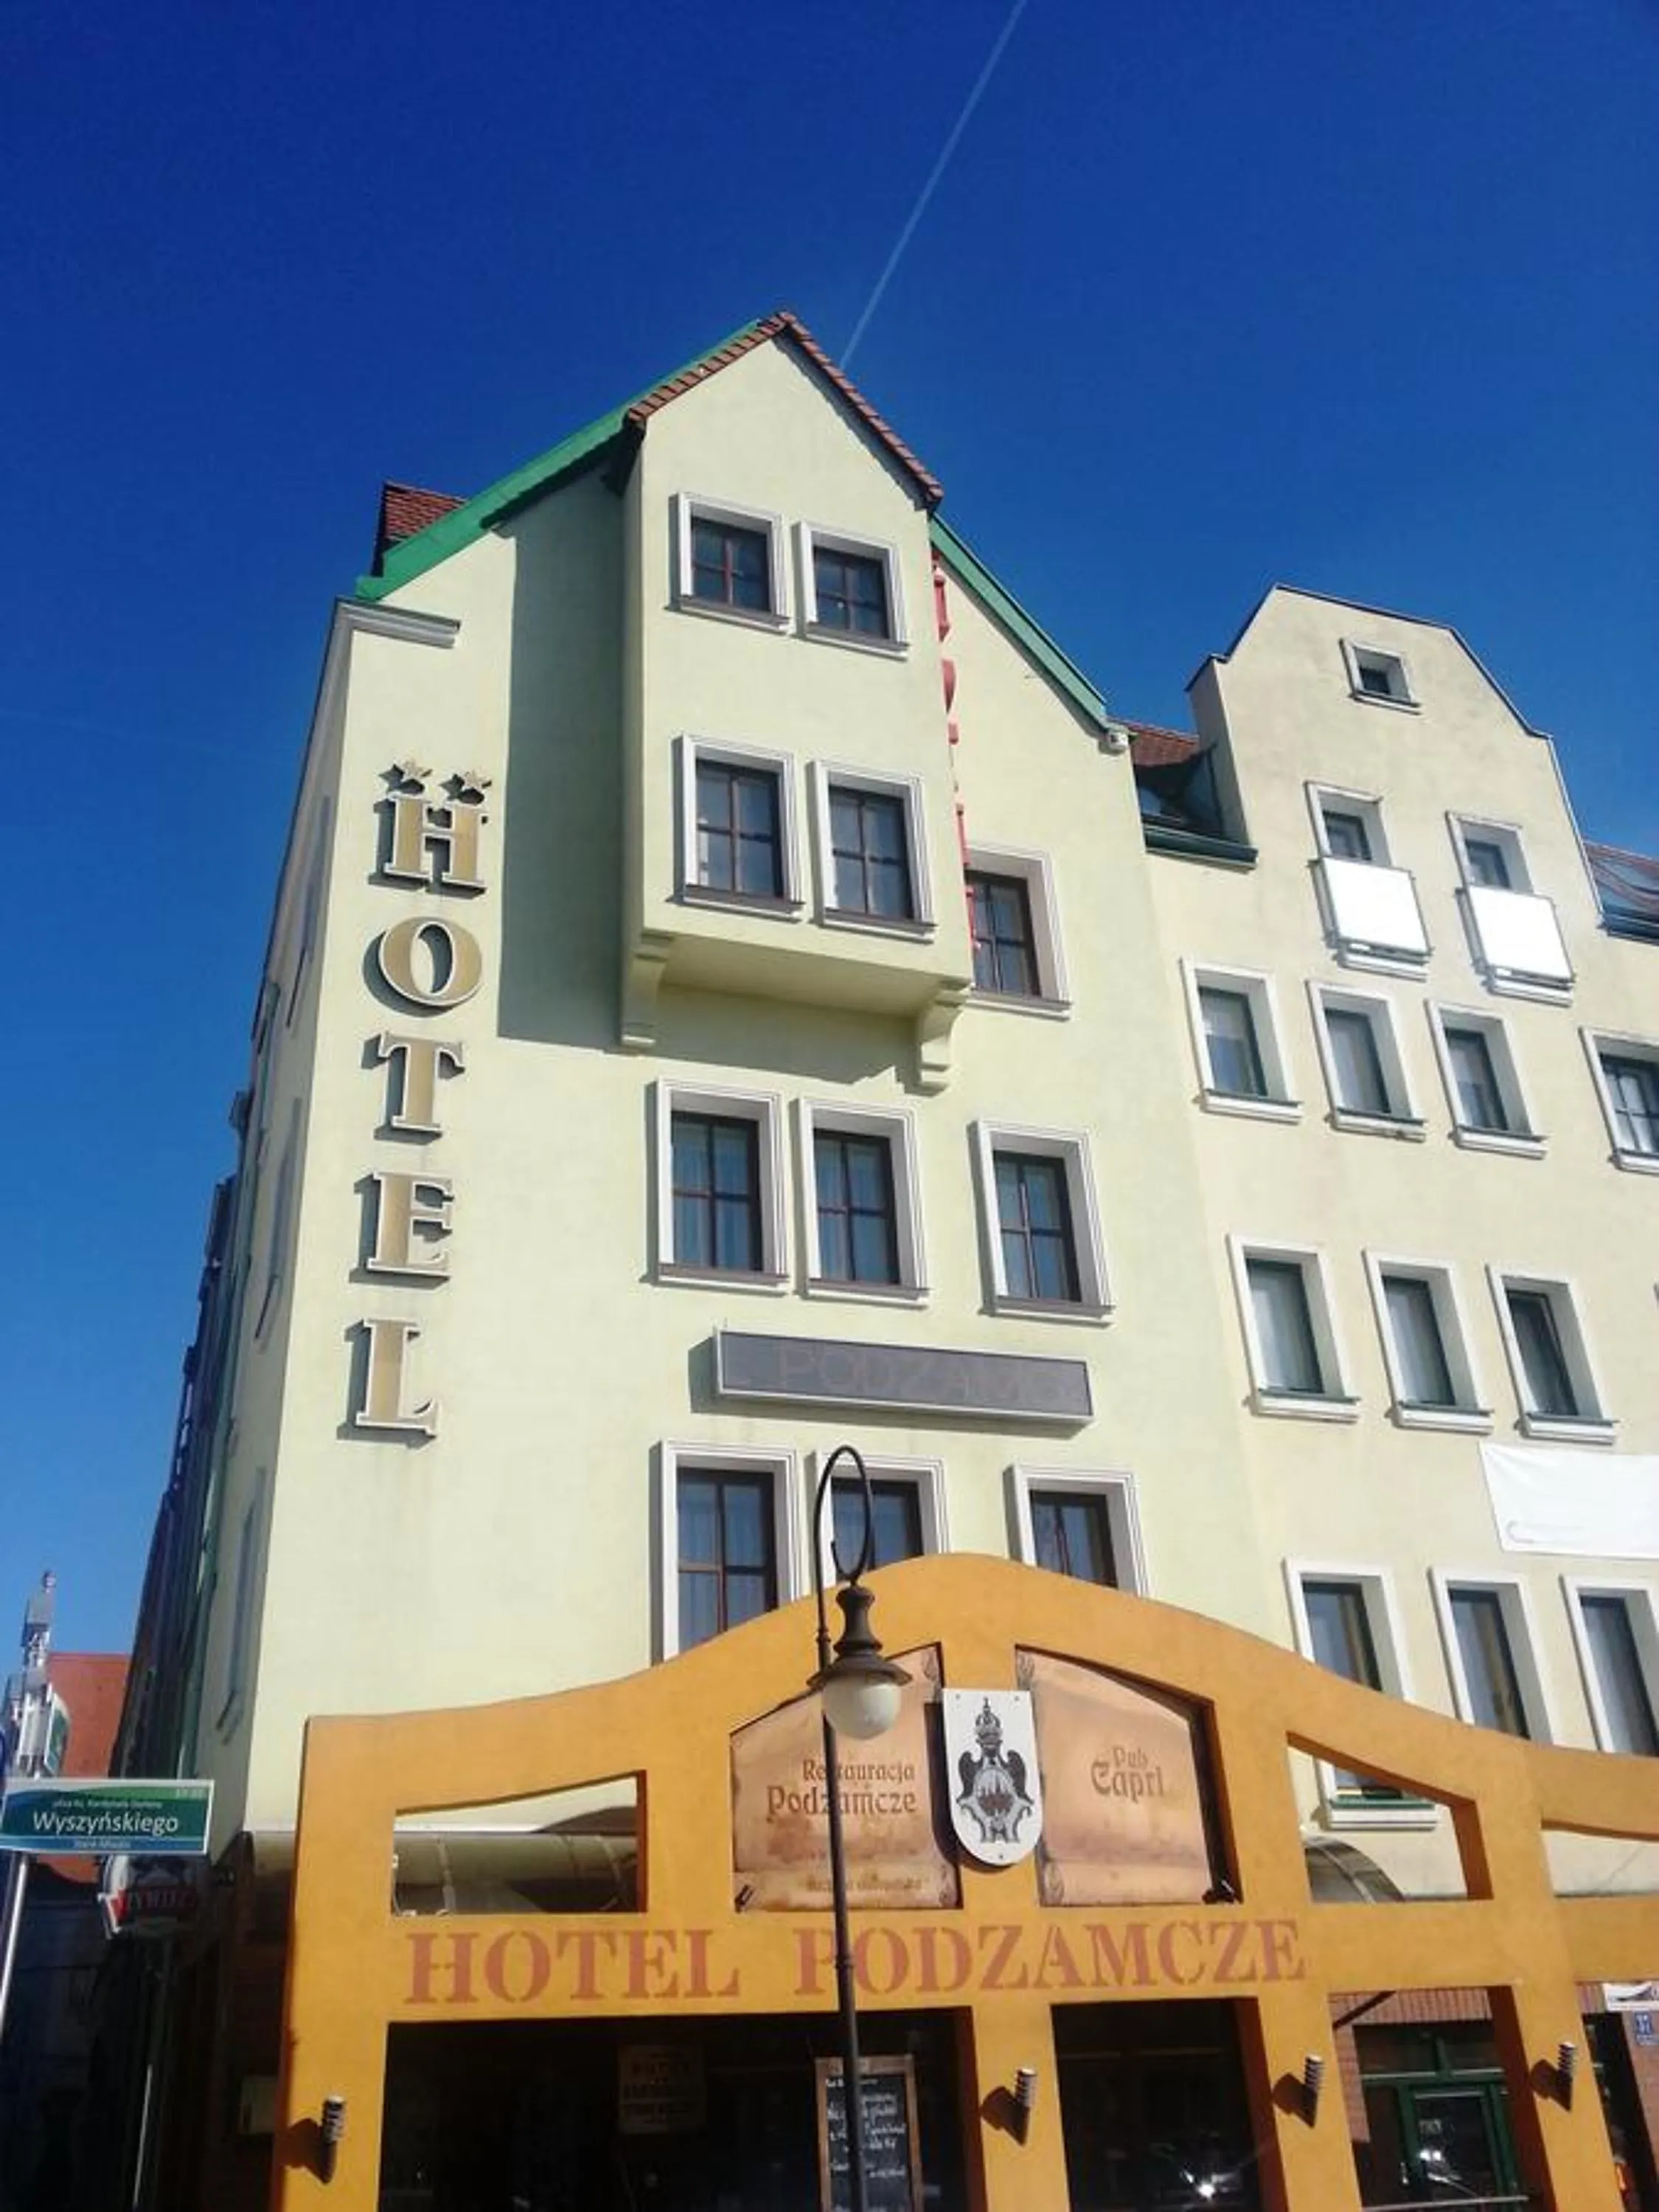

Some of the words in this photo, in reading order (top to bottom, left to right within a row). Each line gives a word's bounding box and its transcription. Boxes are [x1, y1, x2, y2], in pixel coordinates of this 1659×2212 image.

[357, 793, 487, 1436] HOTEL
[802, 1759, 916, 1783] Retauracja
[1112, 1745, 1149, 1770] Pub
[1091, 1760, 1164, 1804] Capri
[33, 1811, 178, 1837] Wyszyńskiego
[404, 1928, 740, 2006] HOTEL
[793, 1917, 1306, 1996] PODZAMCZE
